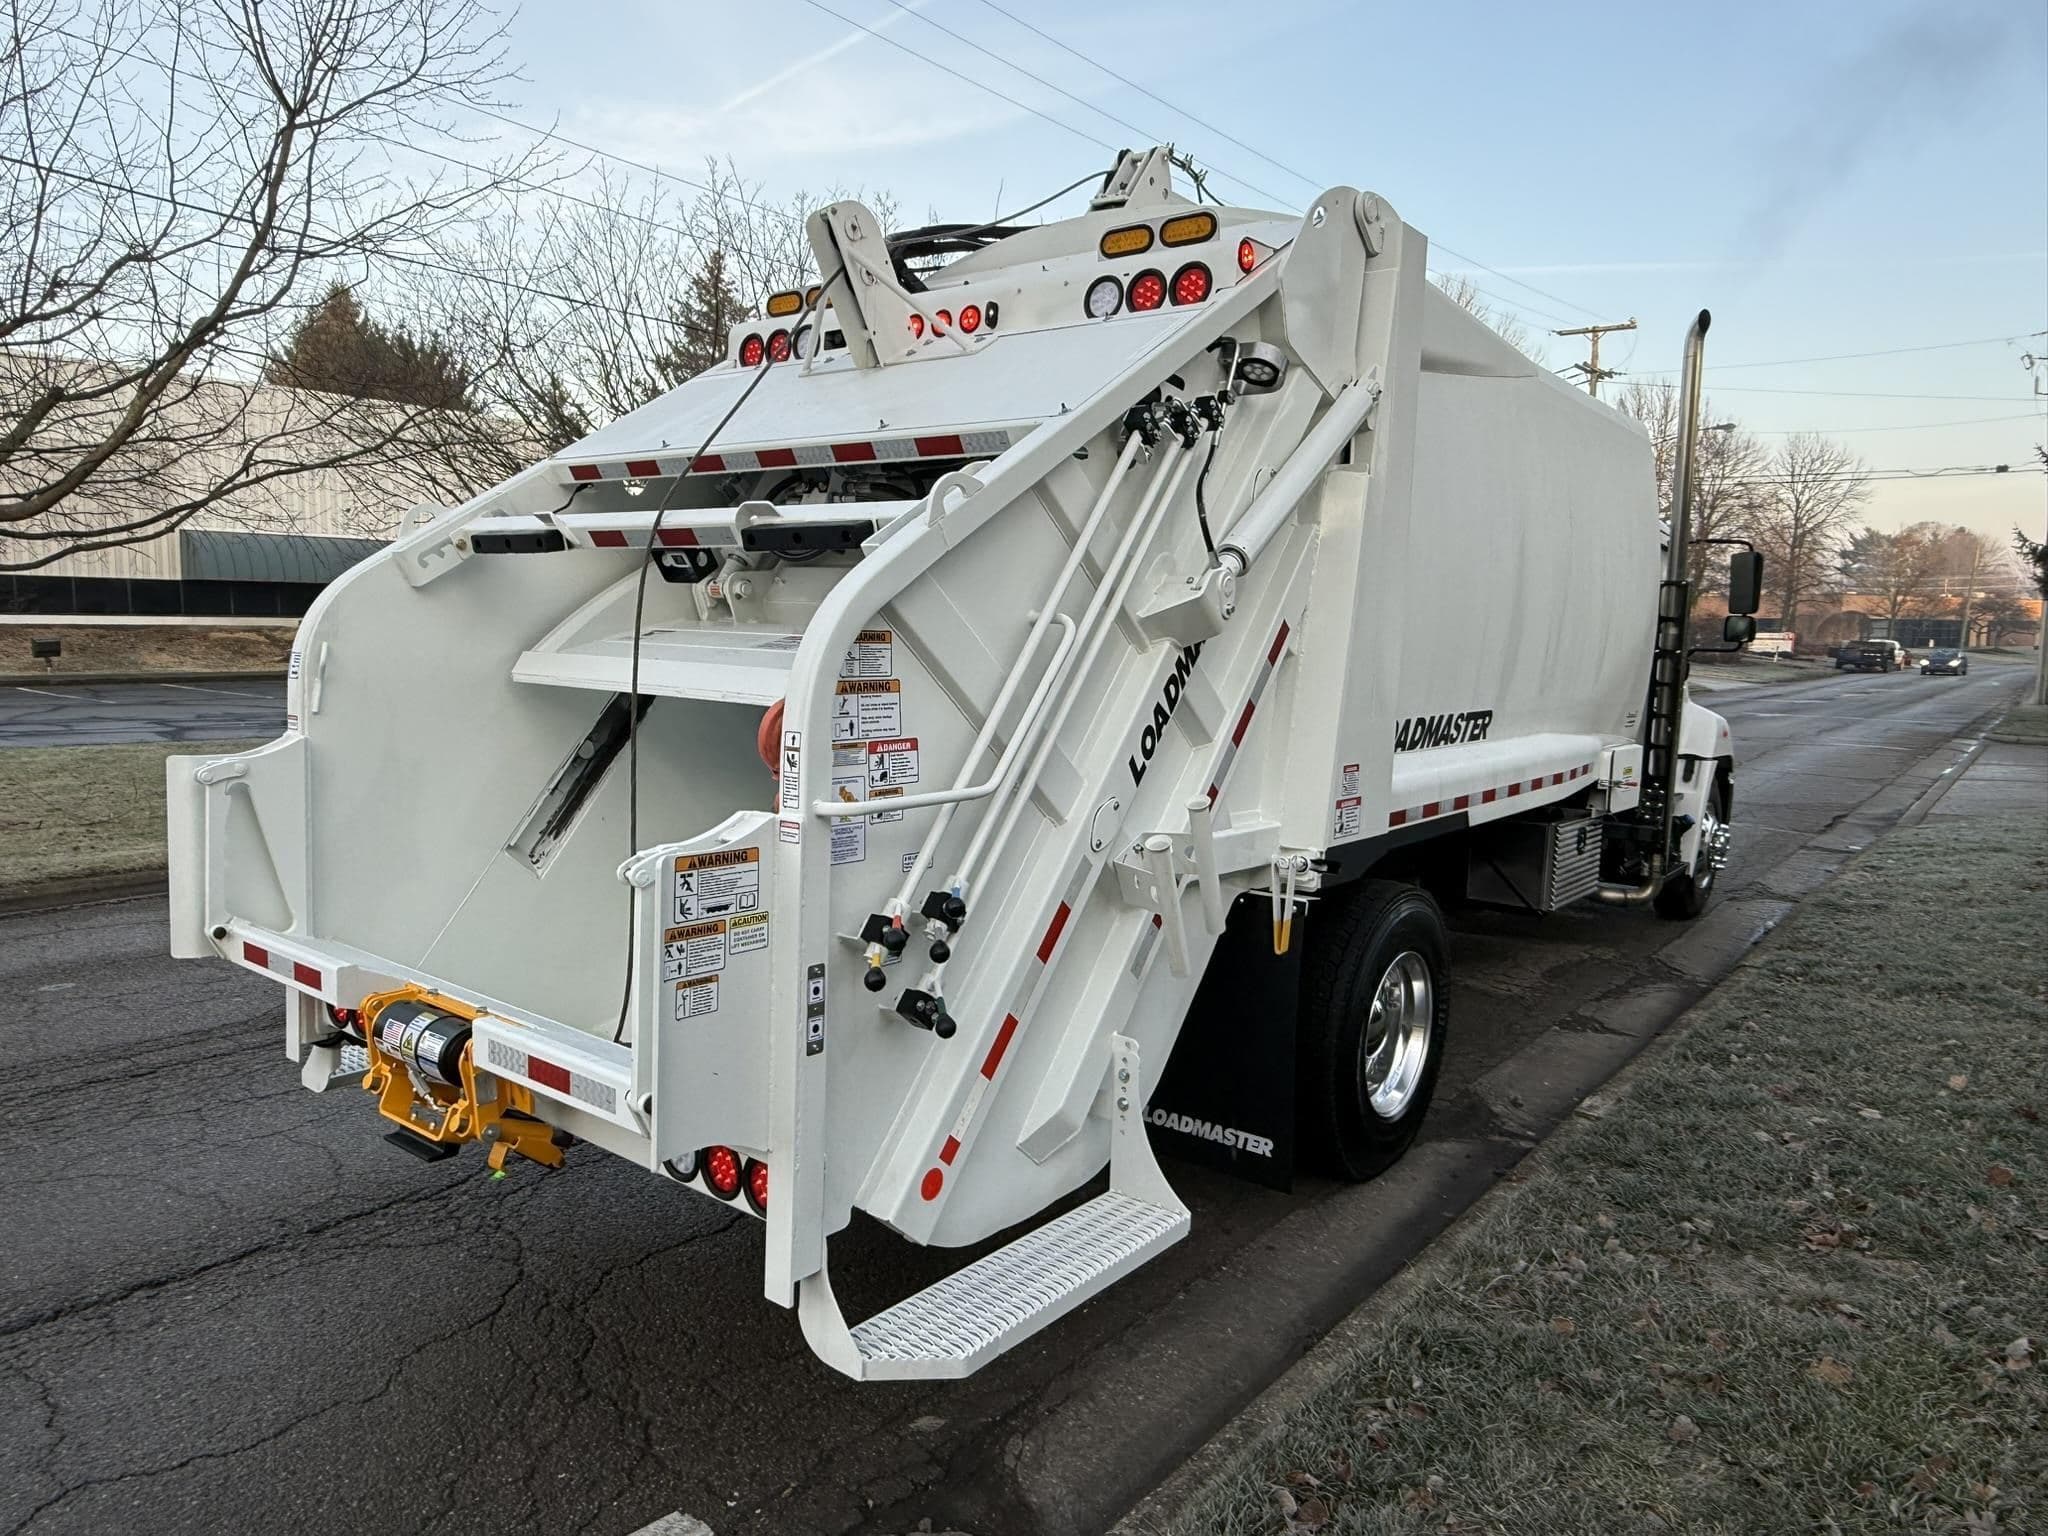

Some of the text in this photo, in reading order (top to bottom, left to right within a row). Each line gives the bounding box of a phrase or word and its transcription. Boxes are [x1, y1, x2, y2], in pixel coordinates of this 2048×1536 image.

[848, 681, 891, 693] WARNING
[1394, 709, 1493, 753] ADMASTER
[884, 742, 911, 752] DANGER
[698, 851, 748, 867] WARNING
[738, 914, 767, 926] CAUTION
[677, 923, 718, 938] WARNING
[1142, 1105, 1274, 1158] LOADMASTER
